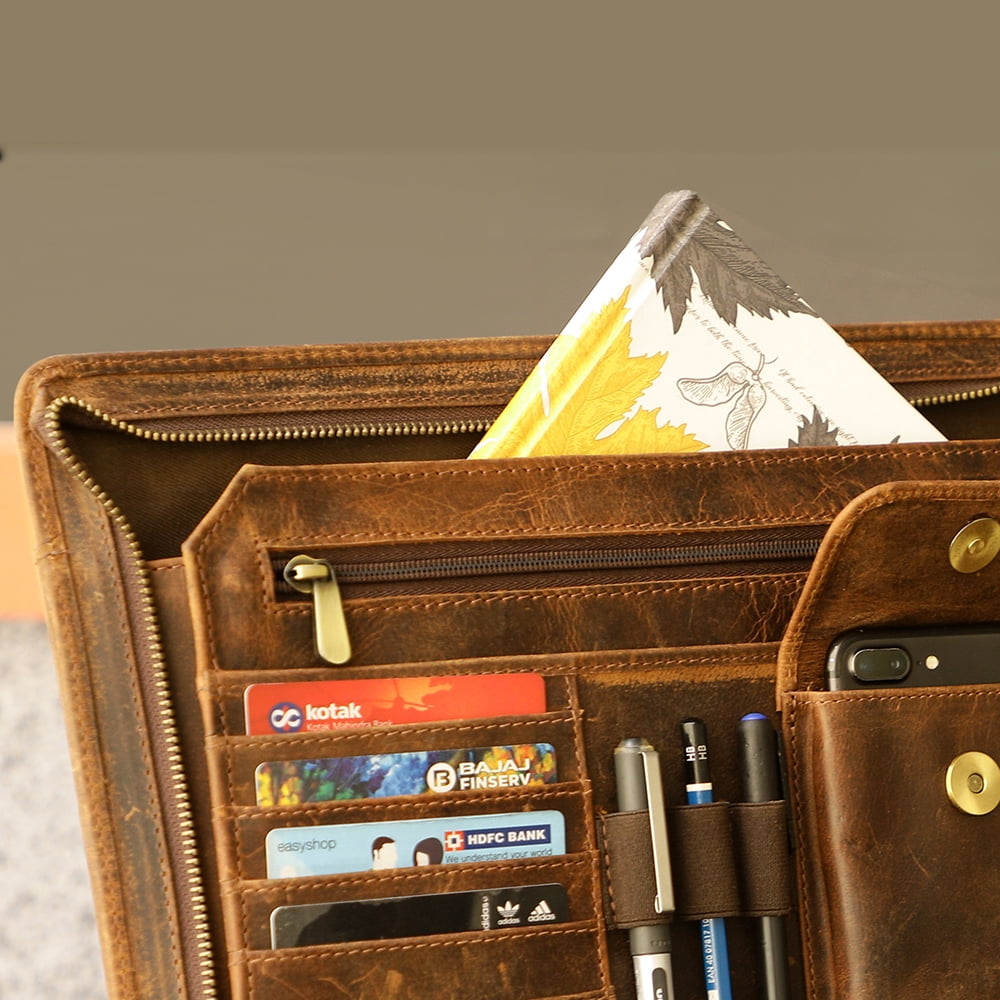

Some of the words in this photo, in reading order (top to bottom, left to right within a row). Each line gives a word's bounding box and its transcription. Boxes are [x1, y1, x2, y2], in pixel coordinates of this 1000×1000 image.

[305, 702, 362, 720] kotak
[685, 746, 696, 762] HB
[697, 744, 708, 760] HB
[459, 758, 531, 776] BAJAJ
[460, 773, 531, 790] FINSERV
[467, 832, 505, 845] HDFC
[508, 829, 546, 842] BANK
[277, 838, 337, 853] easyshop
[445, 854, 460, 863] We
[461, 851, 508, 863] understand
[510, 849, 529, 860] your
[530, 848, 553, 857] world
[497, 918, 520, 926] adidas
[527, 913, 556, 922] adidas
